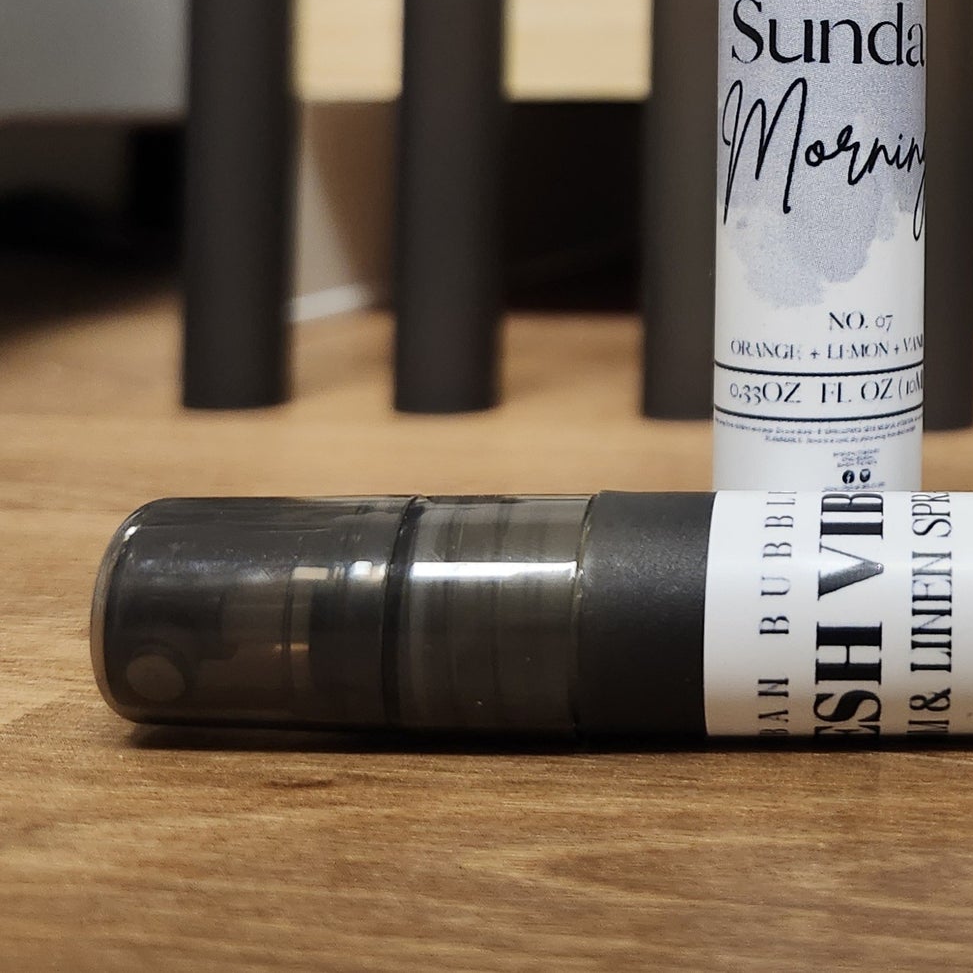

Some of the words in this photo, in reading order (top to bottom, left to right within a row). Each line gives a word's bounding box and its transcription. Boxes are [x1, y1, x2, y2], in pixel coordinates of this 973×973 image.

[829, 311, 869, 331] NO.
[875, 314, 894, 332] 07
[730, 337, 801, 360] ORANGE
[827, 339, 889, 360] LEMON
[729, 380, 802, 406] 0.33OZ
[860, 377, 894, 402] OZ
[758, 491, 798, 635] BUBBL
[910, 551, 953, 673] LINEN
[908, 687, 952, 713] &
